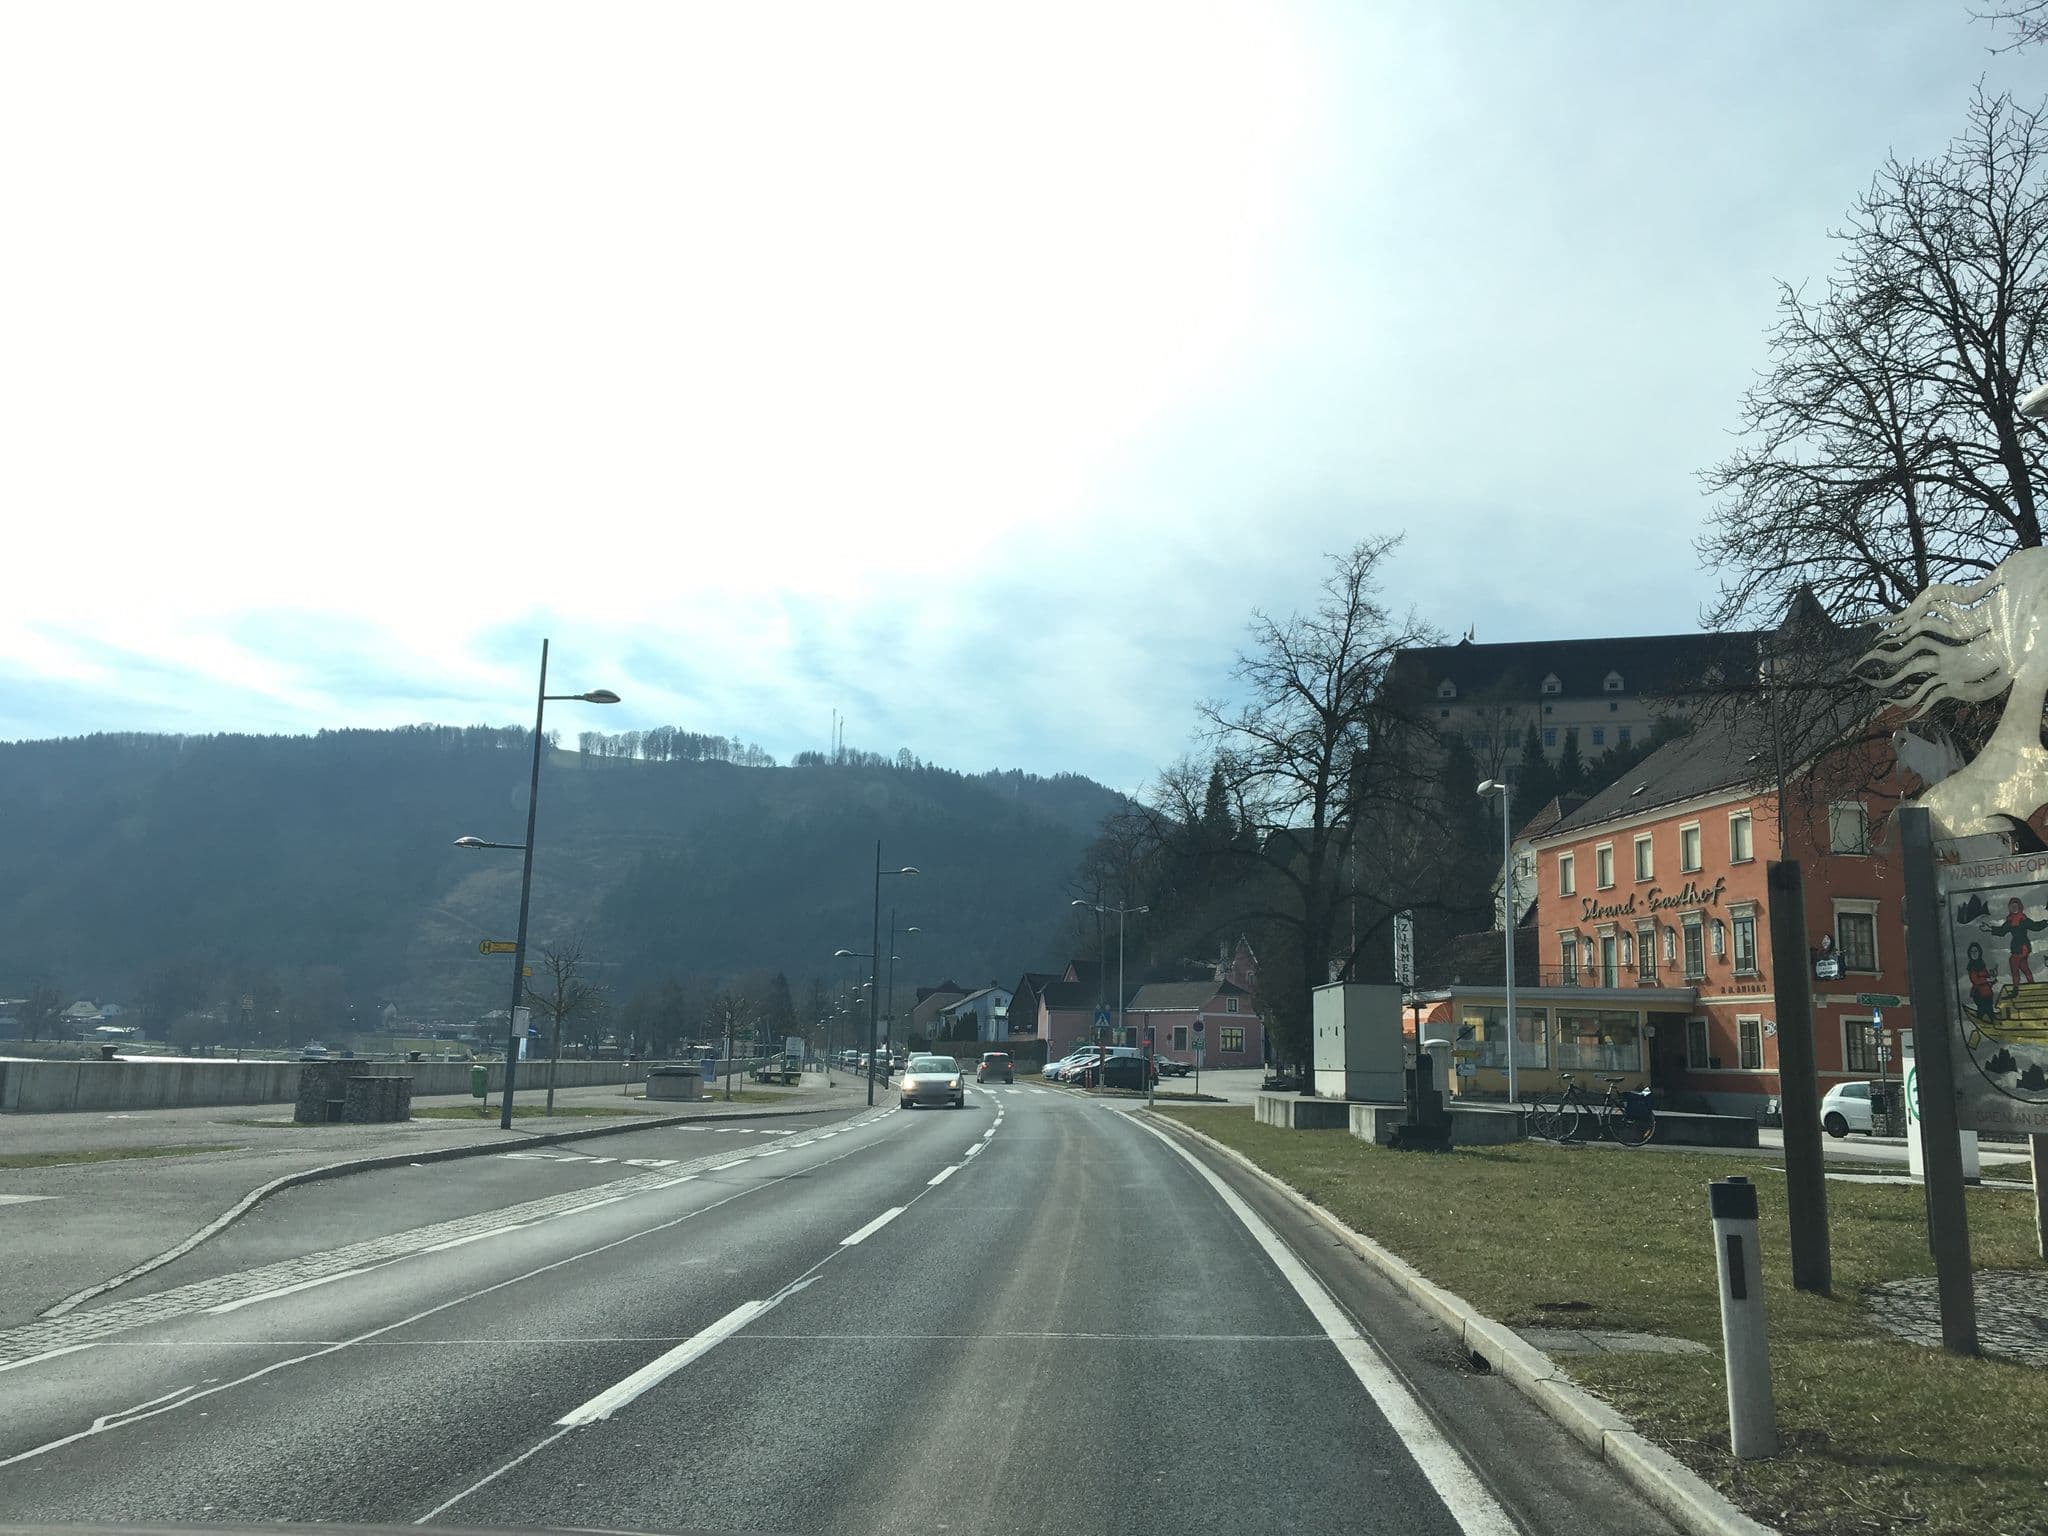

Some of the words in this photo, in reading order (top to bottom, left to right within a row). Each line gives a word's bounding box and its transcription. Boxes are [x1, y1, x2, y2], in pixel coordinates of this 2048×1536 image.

[1579, 893, 1636, 921] Strand
[1647, 876, 1727, 912] Gasthof
[1400, 923, 1410, 983] ZIMMER
[496, 1153, 680, 1167] BUS
